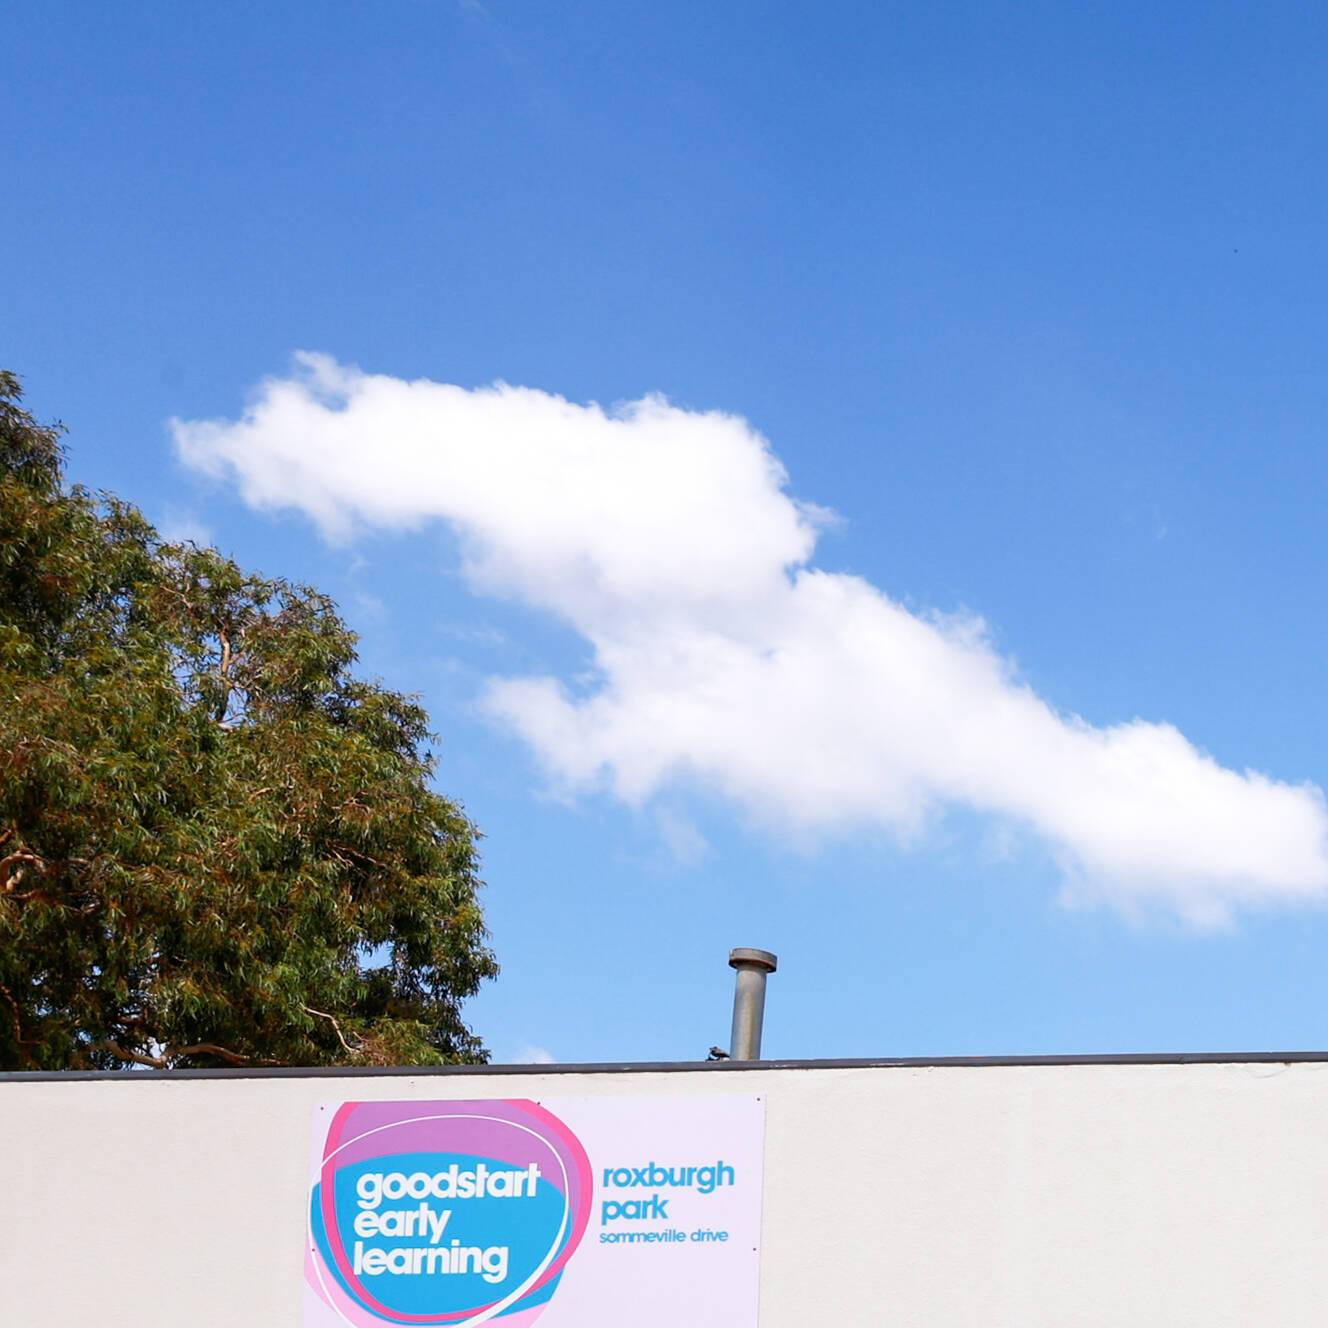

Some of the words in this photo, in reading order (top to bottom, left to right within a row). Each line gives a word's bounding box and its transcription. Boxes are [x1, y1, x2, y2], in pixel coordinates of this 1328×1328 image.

[356, 1162, 541, 1210] goodstart
[603, 1160, 735, 1194] roxburgh
[353, 1202, 451, 1244] early
[601, 1194, 669, 1226] park
[599, 1229, 687, 1244] sommeville
[690, 1228, 729, 1242] drive
[353, 1239, 509, 1284] learning
